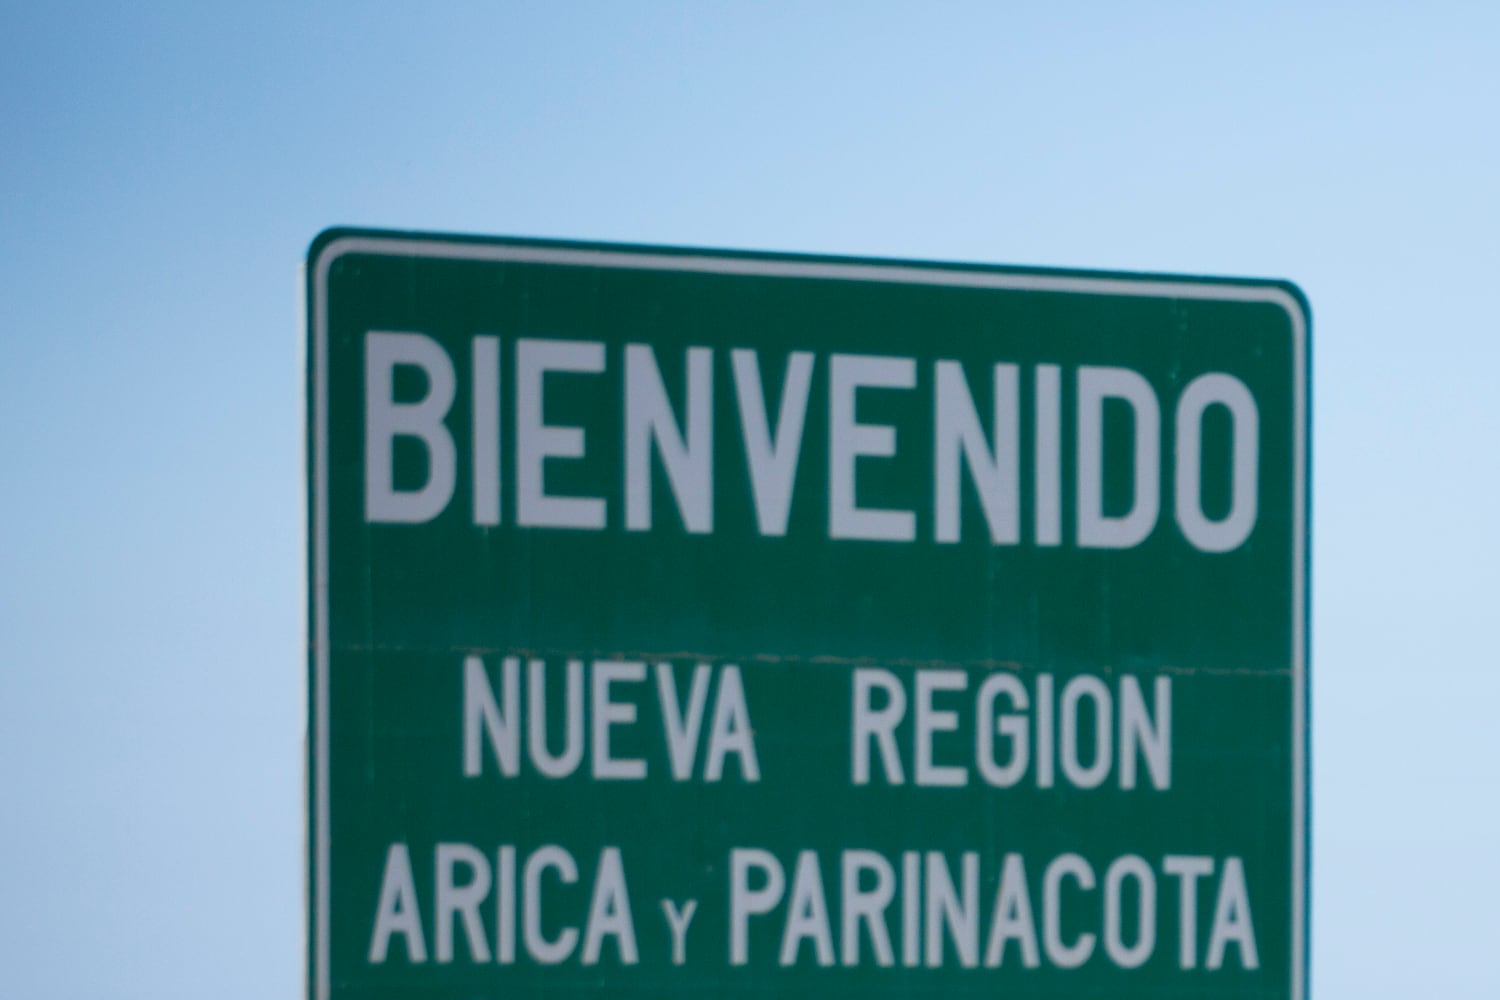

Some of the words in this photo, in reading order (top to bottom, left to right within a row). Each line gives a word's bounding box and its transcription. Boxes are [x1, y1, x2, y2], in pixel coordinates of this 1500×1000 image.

[365, 331, 1259, 553] BIENVENIDO
[463, 656, 760, 782] NUEVA
[851, 667, 1172, 791] REGION
[369, 842, 638, 965] ARICA
[660, 897, 698, 965] Y
[729, 847, 1259, 970] PARINACOTA
